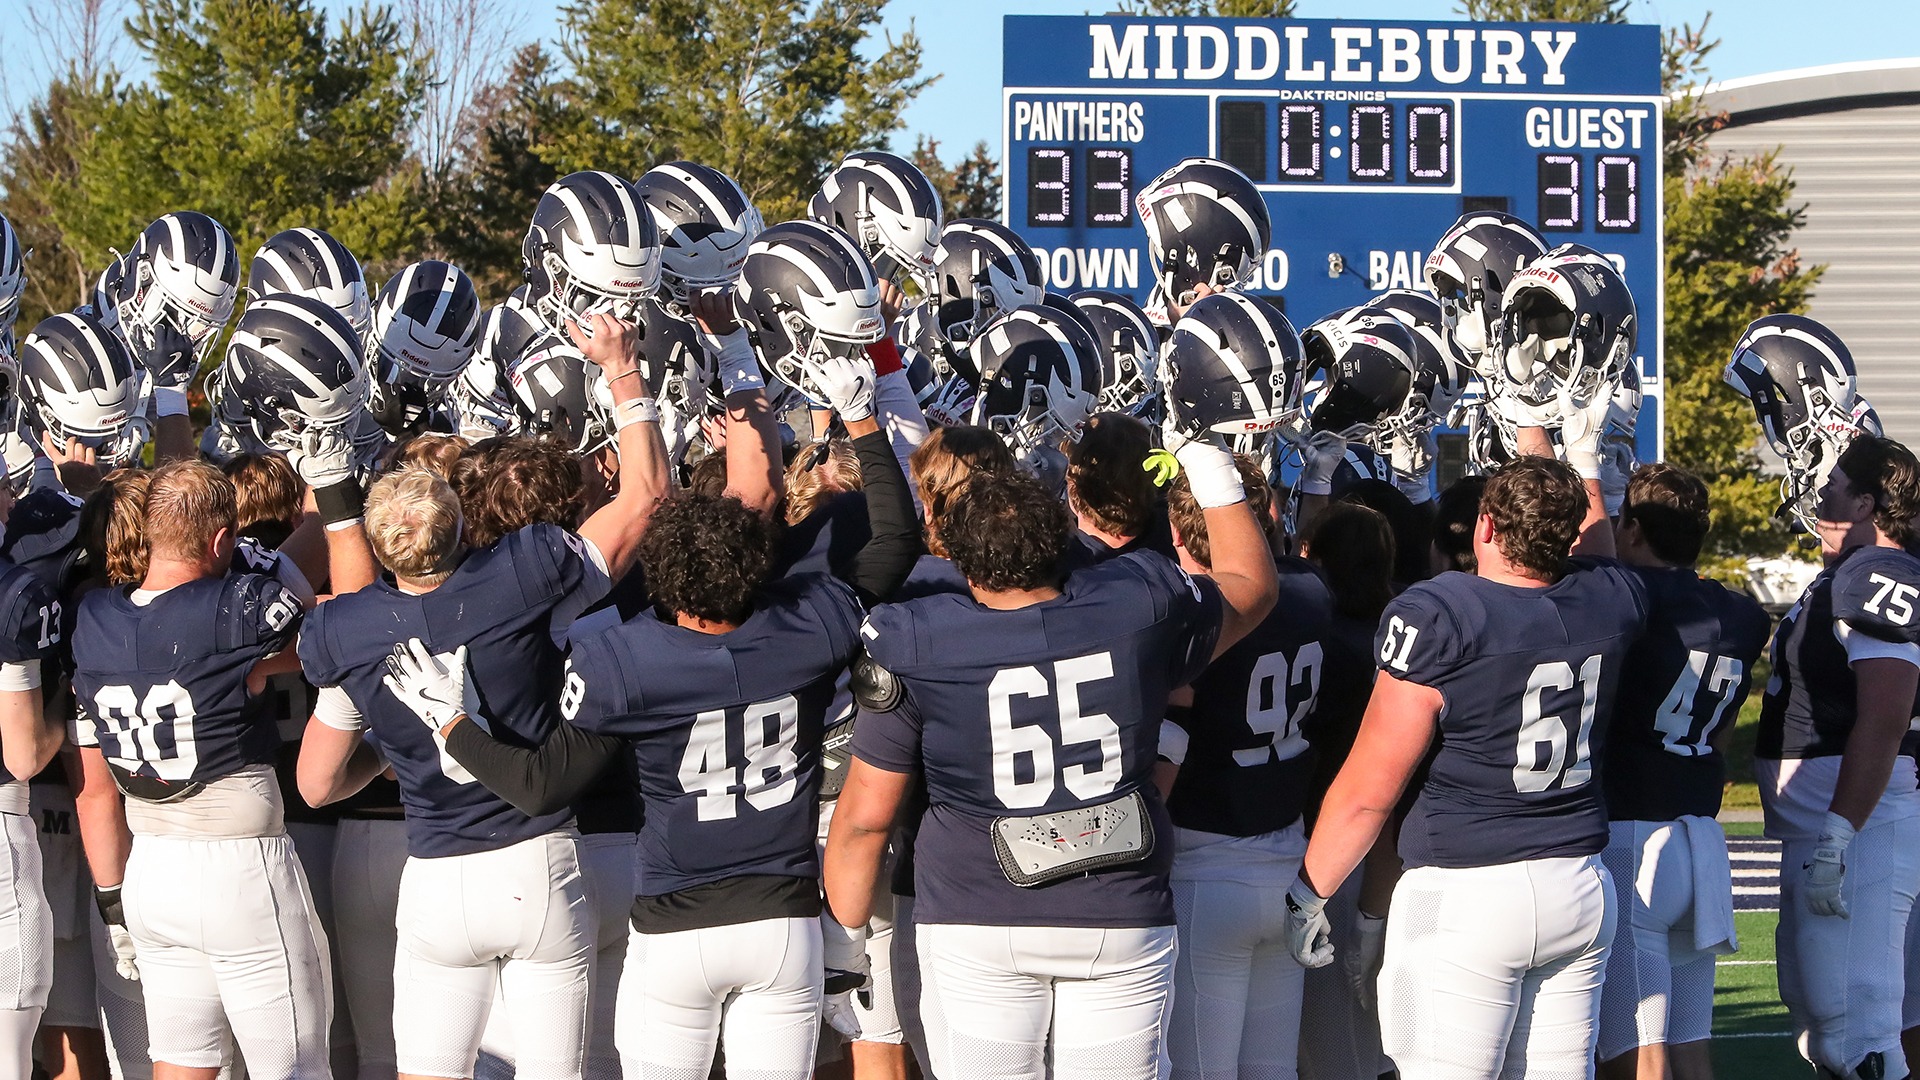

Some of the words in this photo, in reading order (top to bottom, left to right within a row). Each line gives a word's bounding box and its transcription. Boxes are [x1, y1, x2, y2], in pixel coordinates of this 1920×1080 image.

[1089, 24, 1577, 86] MIDDLEBURY
[1014, 101, 1145, 143] PANTHERS
[1280, 90, 1386, 102] DAKTRONICS
[1281, 105, 1448, 178] 0:00
[1525, 106, 1649, 150] GUEST
[1035, 150, 1129, 222] 33
[1544, 155, 1636, 228] 30
[1325, 320, 1349, 349] VICIS
[1361, 316, 1375, 328] 36
[401, 348, 431, 368] Riddell
[1272, 373, 1284, 386] 65
[37, 599, 63, 650] 13
[1862, 572, 1920, 626] 75
[1380, 614, 1419, 673] 61
[987, 650, 1124, 810] 65
[1231, 640, 1325, 768] 92
[1512, 653, 1603, 794] 61
[1653, 648, 1744, 757] 47
[677, 692, 799, 823] 48
[42, 808, 72, 835] M
